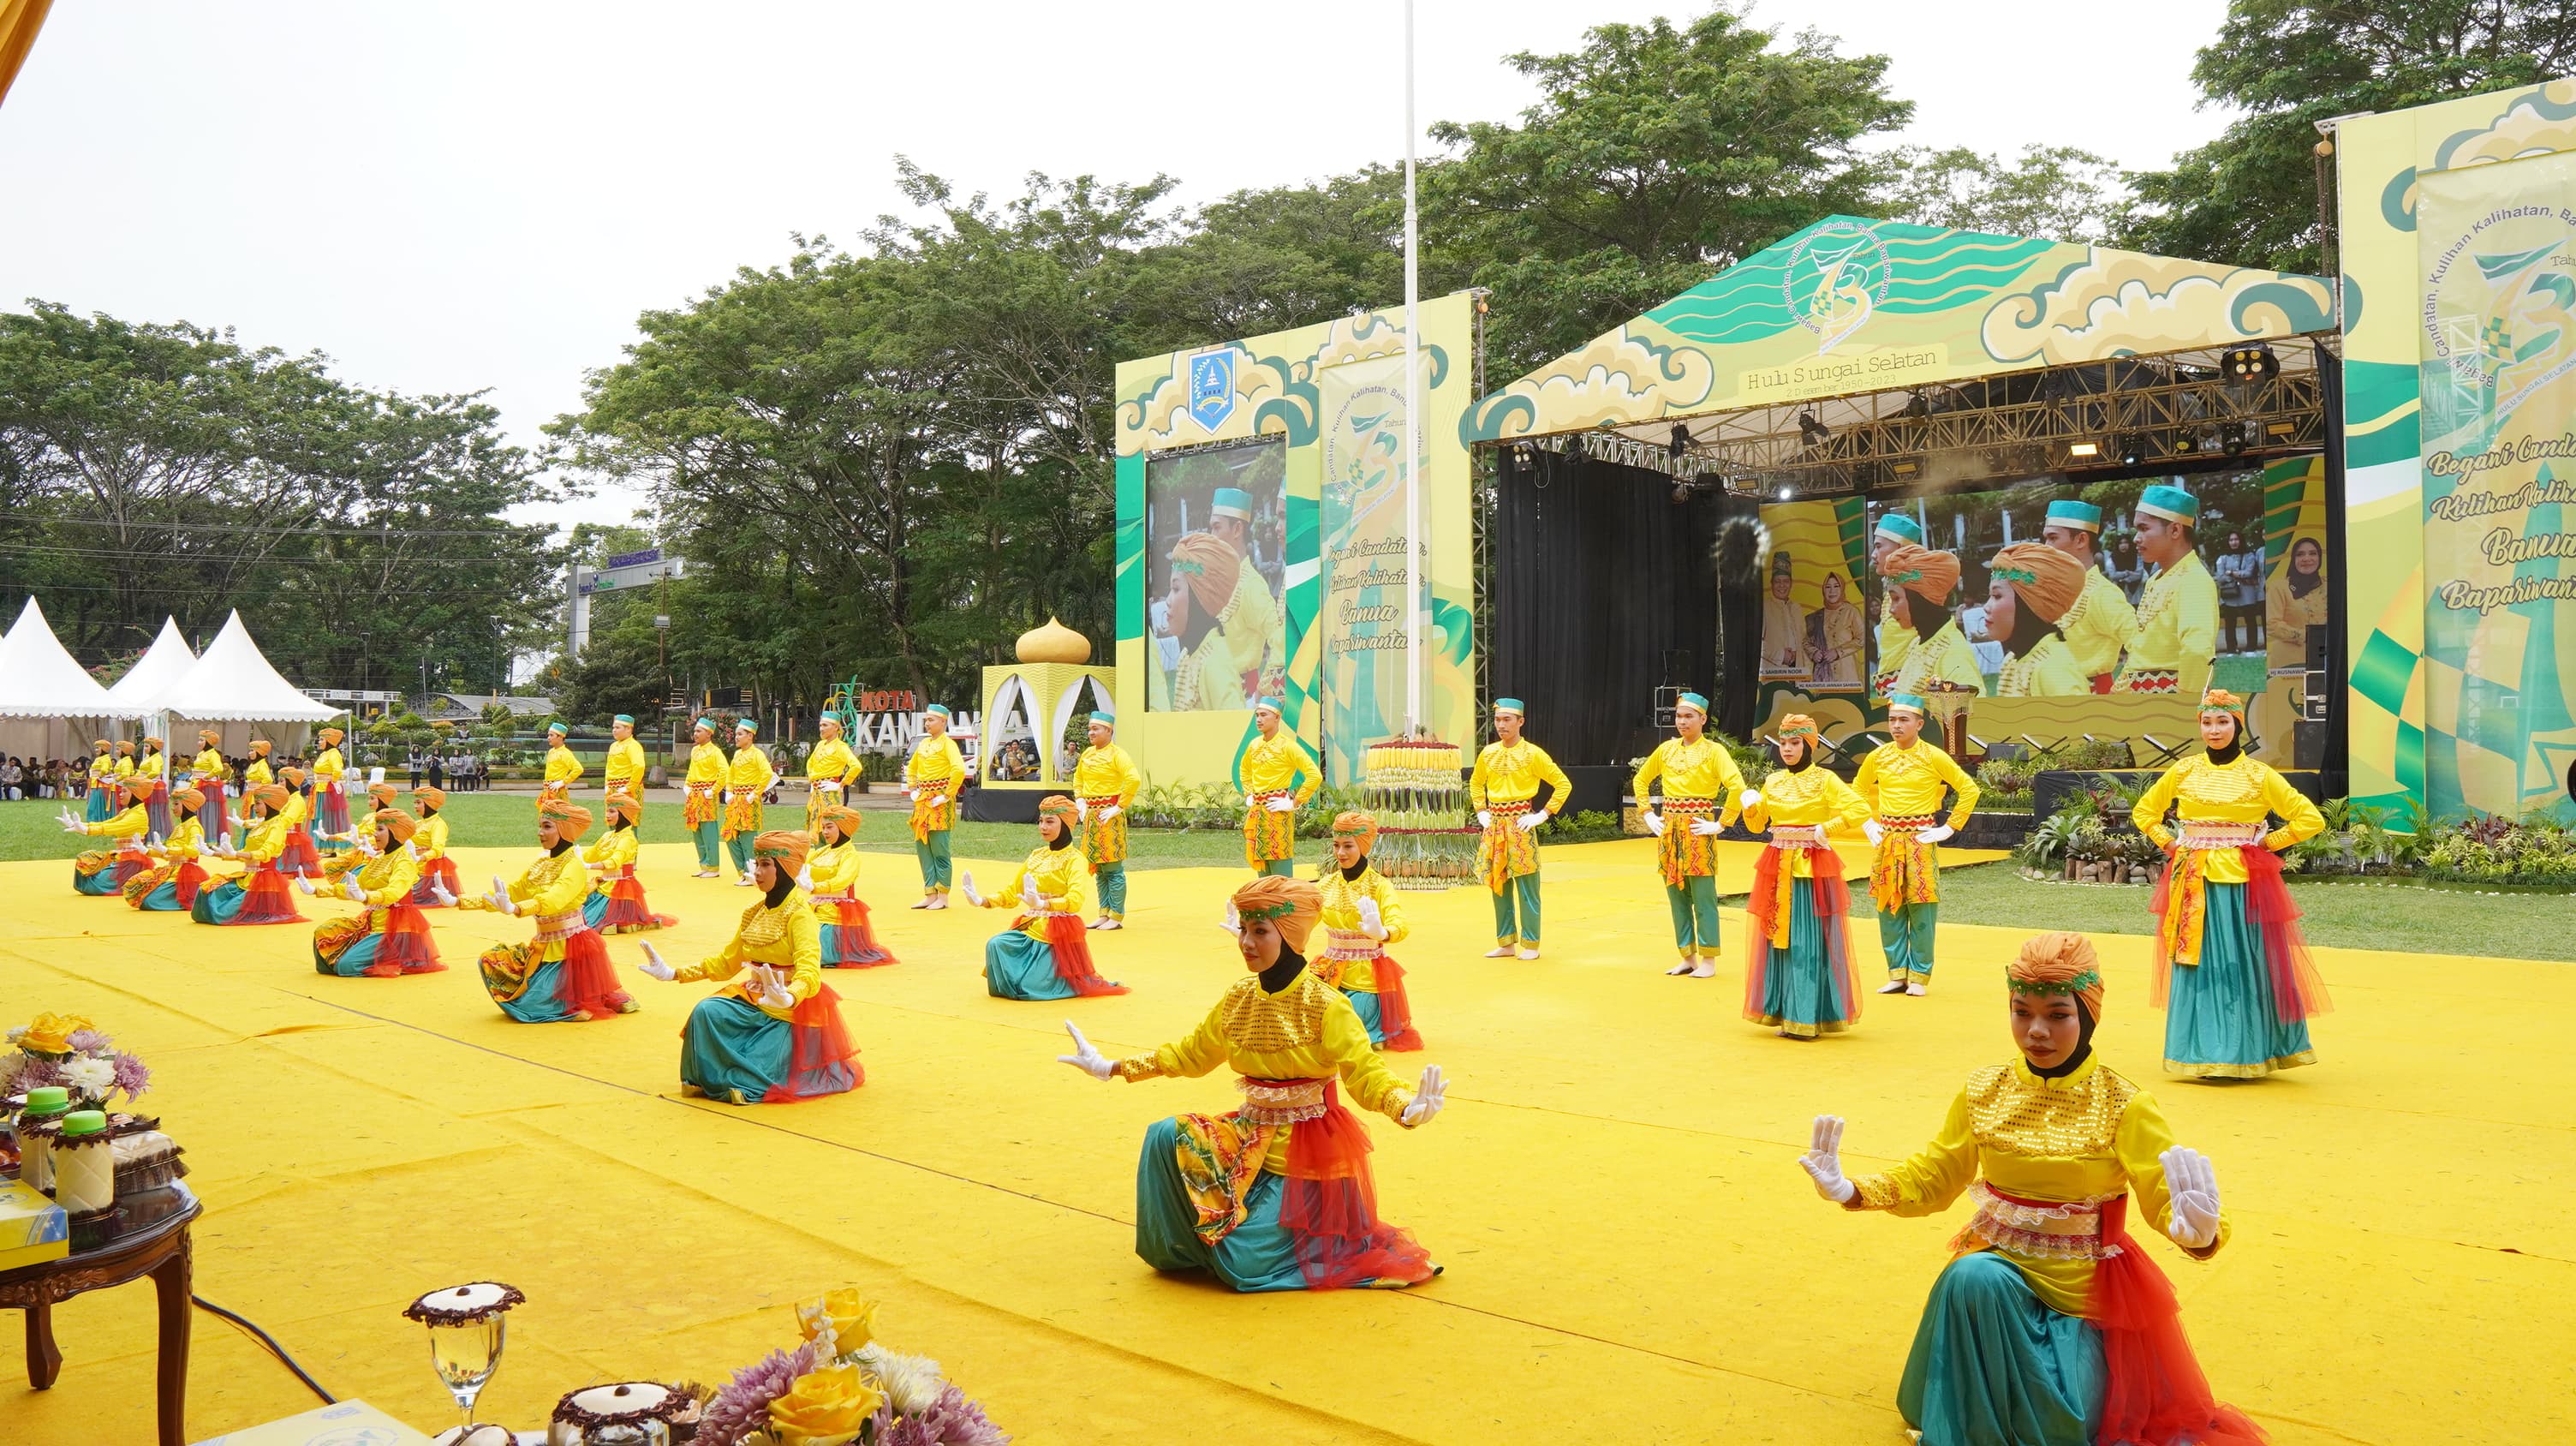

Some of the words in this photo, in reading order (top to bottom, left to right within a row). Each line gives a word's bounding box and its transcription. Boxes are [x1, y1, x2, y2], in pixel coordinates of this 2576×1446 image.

[2429, 234, 2472, 284] Kulihan
[2472, 206, 2554, 234] Kalihatan,
[1748, 370, 1788, 390] Hulu
[1869, 351, 1937, 373] Selatan
[2496, 398, 2516, 416] HULU
[2430, 490, 2525, 522] Kulihan
[2481, 527, 2576, 565] Banua
[1339, 599, 1398, 625] Banua
[861, 690, 915, 712] KOTA
